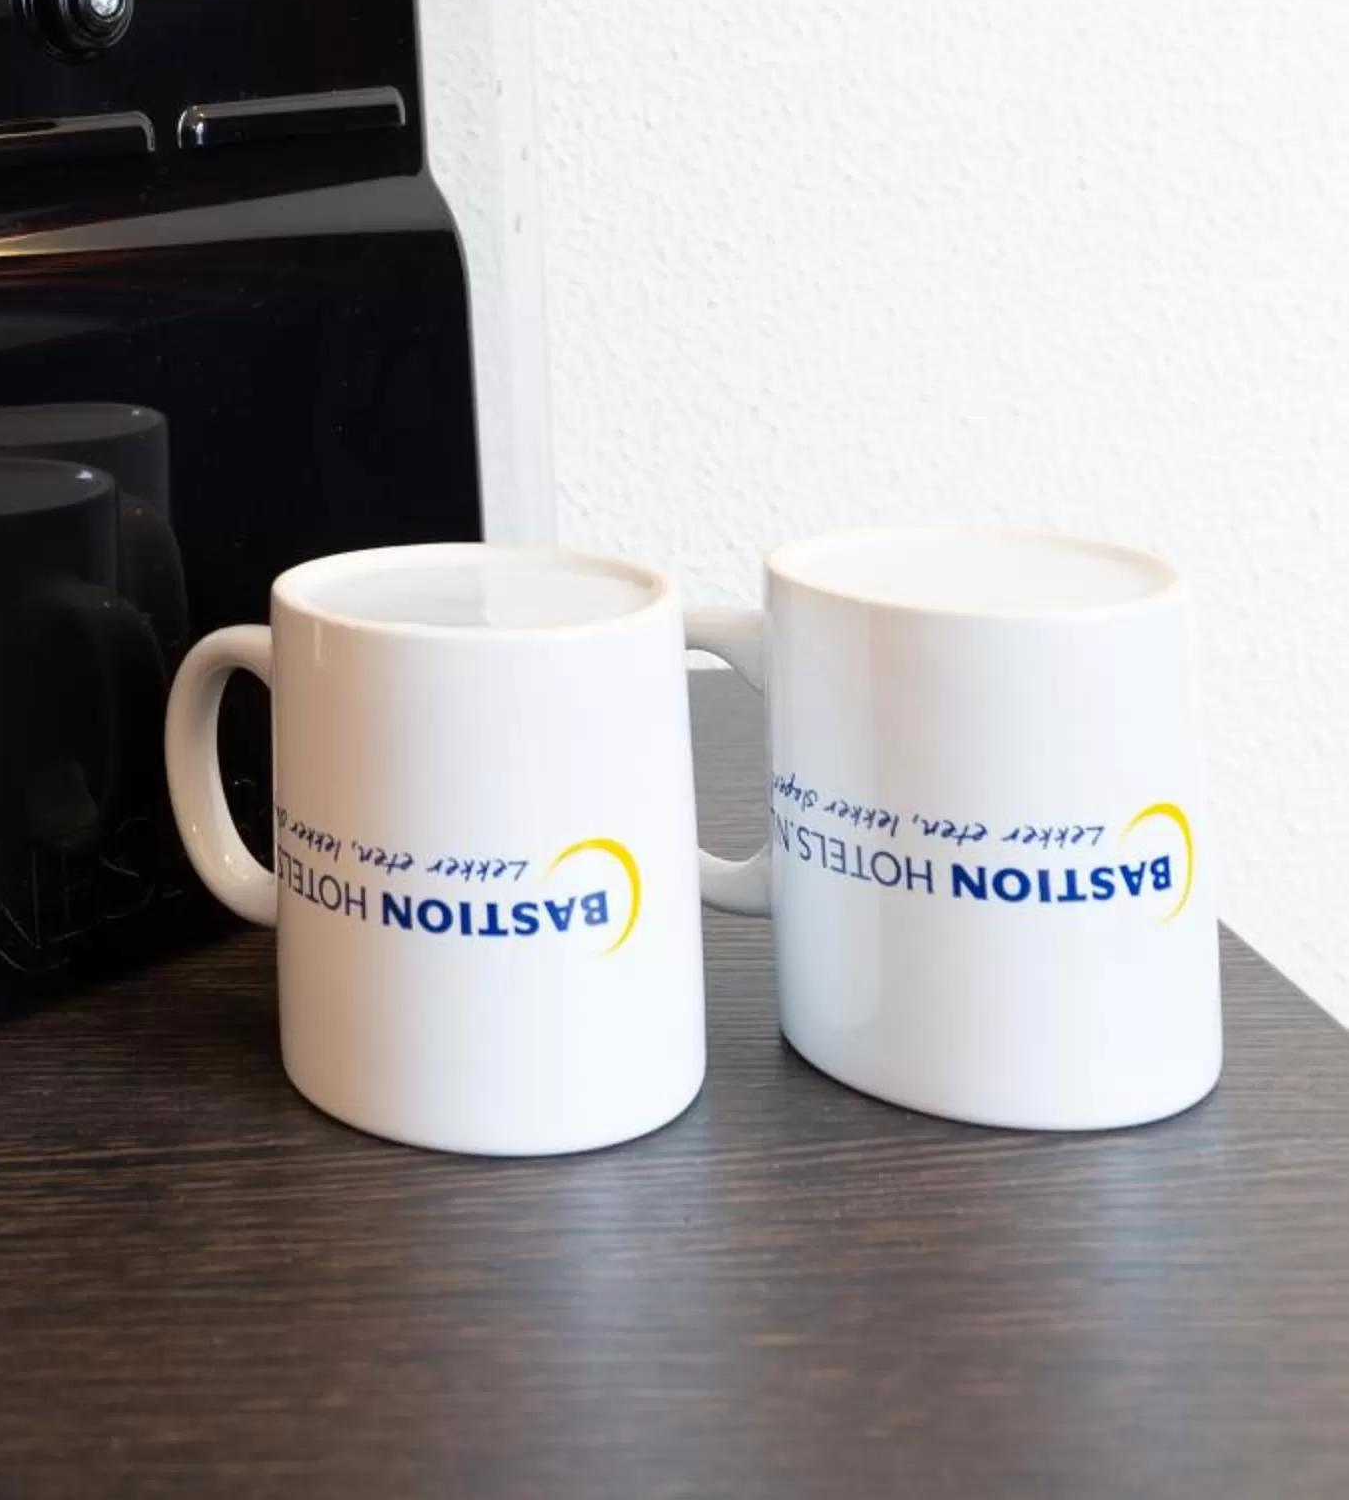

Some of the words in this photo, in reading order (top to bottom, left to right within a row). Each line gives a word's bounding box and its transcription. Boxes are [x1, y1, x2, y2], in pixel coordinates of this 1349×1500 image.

[823, 800, 900, 838] lekker
[912, 813, 989, 848] eten,
[1002, 824, 1106, 850] Lekker
[291, 821, 342, 862] lekker
[350, 838, 414, 875] eten,
[426, 859, 529, 883] Lekker
[951, 854, 1173, 904] BASTION
[381, 890, 610, 937] BASTION
